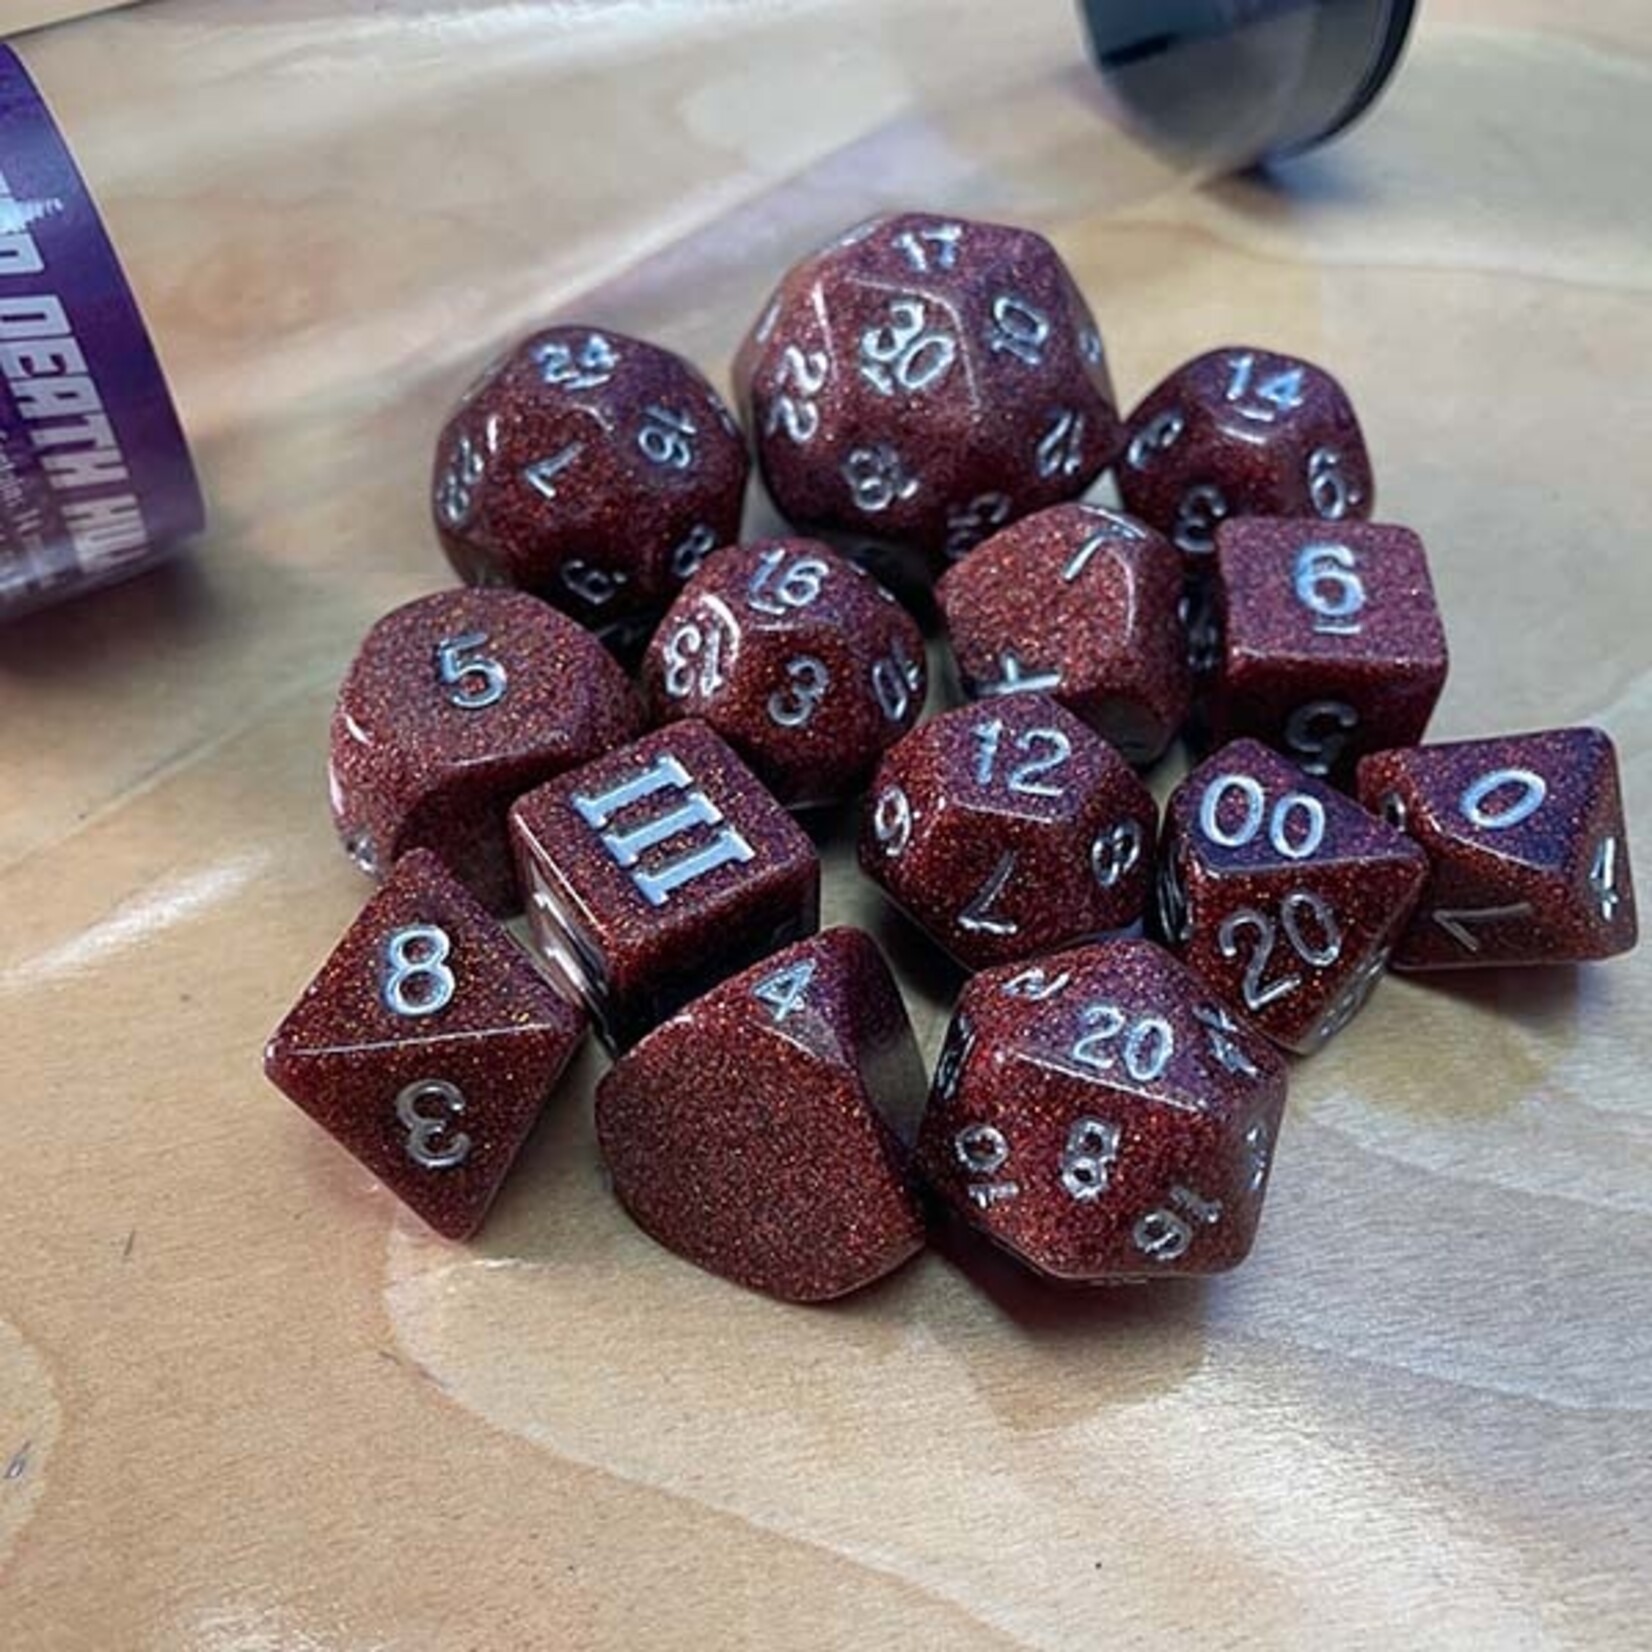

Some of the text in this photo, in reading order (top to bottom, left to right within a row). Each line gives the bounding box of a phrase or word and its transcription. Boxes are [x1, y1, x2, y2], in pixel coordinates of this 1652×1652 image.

[892, 225, 962, 270] 17
[530, 334, 621, 390] 24
[861, 300, 956, 393] 30
[1228, 355, 1303, 407] 14
[1294, 544, 1368, 634] 6
[435, 630, 509, 711] 5
[766, 655, 832, 728] 3
[971, 718, 1072, 797] 12
[573, 754, 756, 906] III
[1200, 774, 1326, 860] 00
[957, 848, 1020, 936] 7
[382, 922, 457, 1018] 8
[752, 957, 818, 1023] 4
[1217, 892, 1343, 1011] 20
[1071, 1003, 1176, 1083] 20
[395, 1077, 472, 1170] 3
